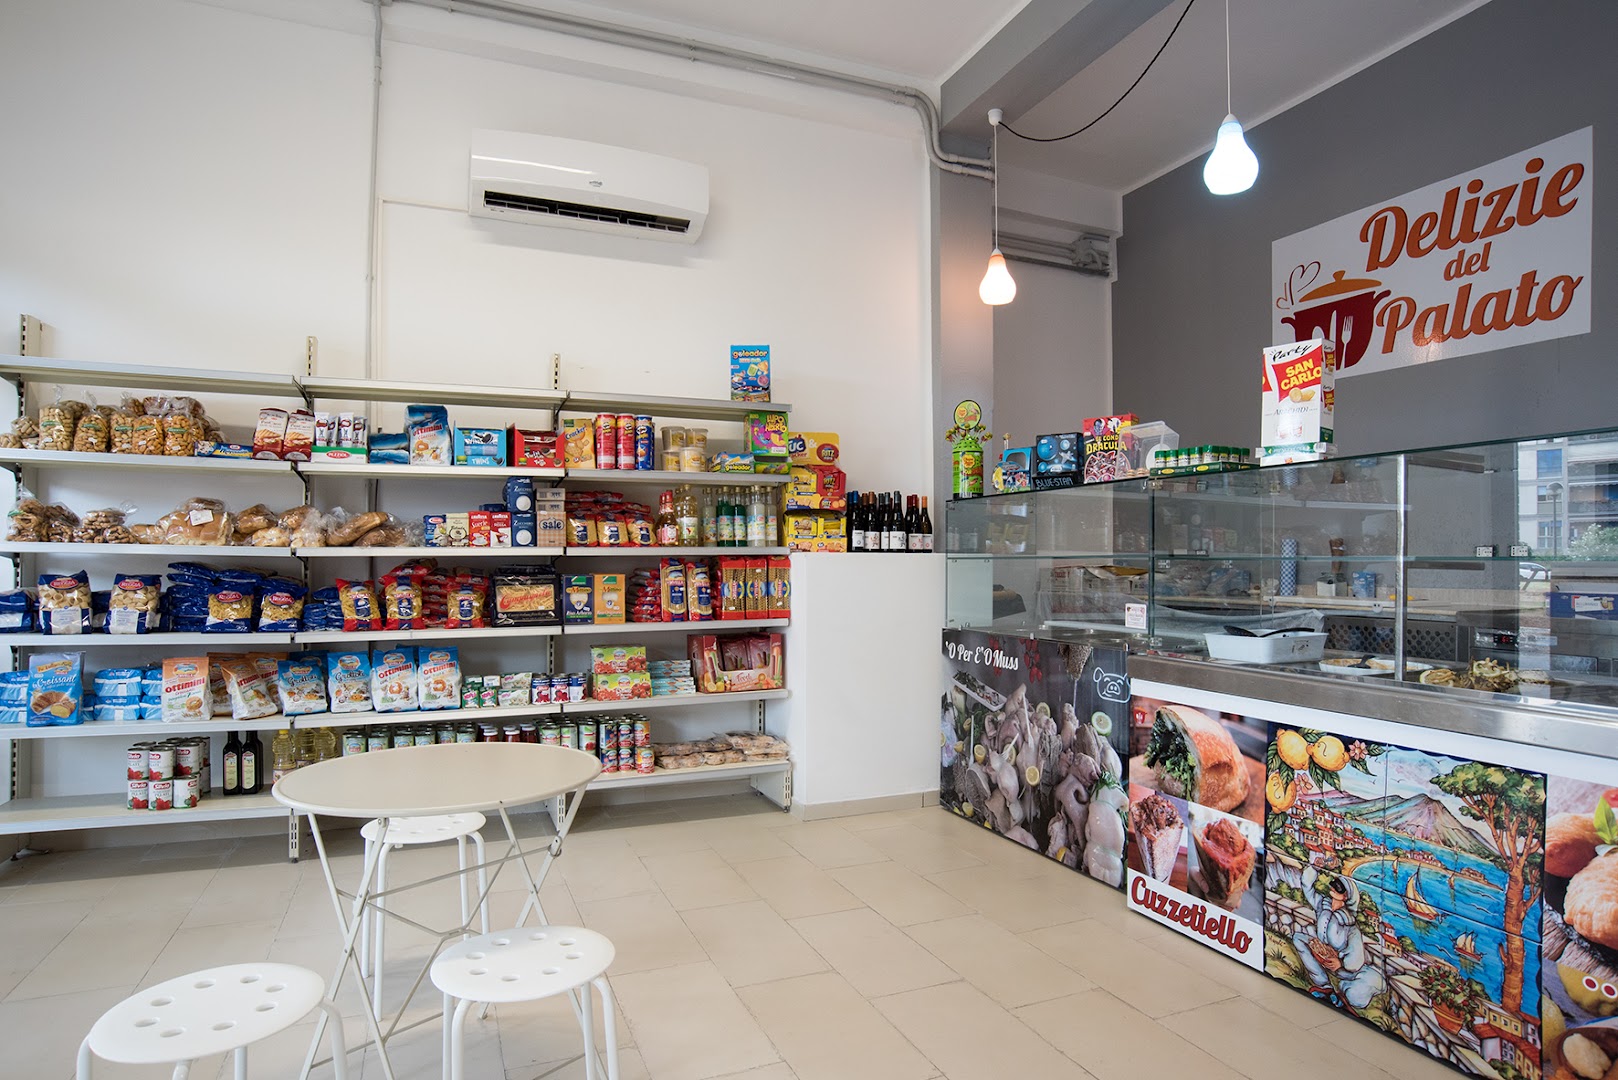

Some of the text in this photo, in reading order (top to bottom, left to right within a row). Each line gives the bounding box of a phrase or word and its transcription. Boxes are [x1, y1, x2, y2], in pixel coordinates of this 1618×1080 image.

[1359, 157, 1585, 273] Delizie
[1443, 241, 1493, 281] del
[1375, 269, 1585, 355] Palato
[733, 349, 768, 359] goleador
[1272, 344, 1312, 363] Party
[1285, 358, 1314, 377] SAN
[1280, 367, 1322, 391] CARLO
[1085, 441, 1128, 455] DRACULA
[542, 519, 562, 530] sale
[957, 643, 973, 662] Per
[993, 649, 1019, 671] Muss
[37, 673, 77, 687] Croissant
[1131, 875, 1252, 955] Cuzzetiello
